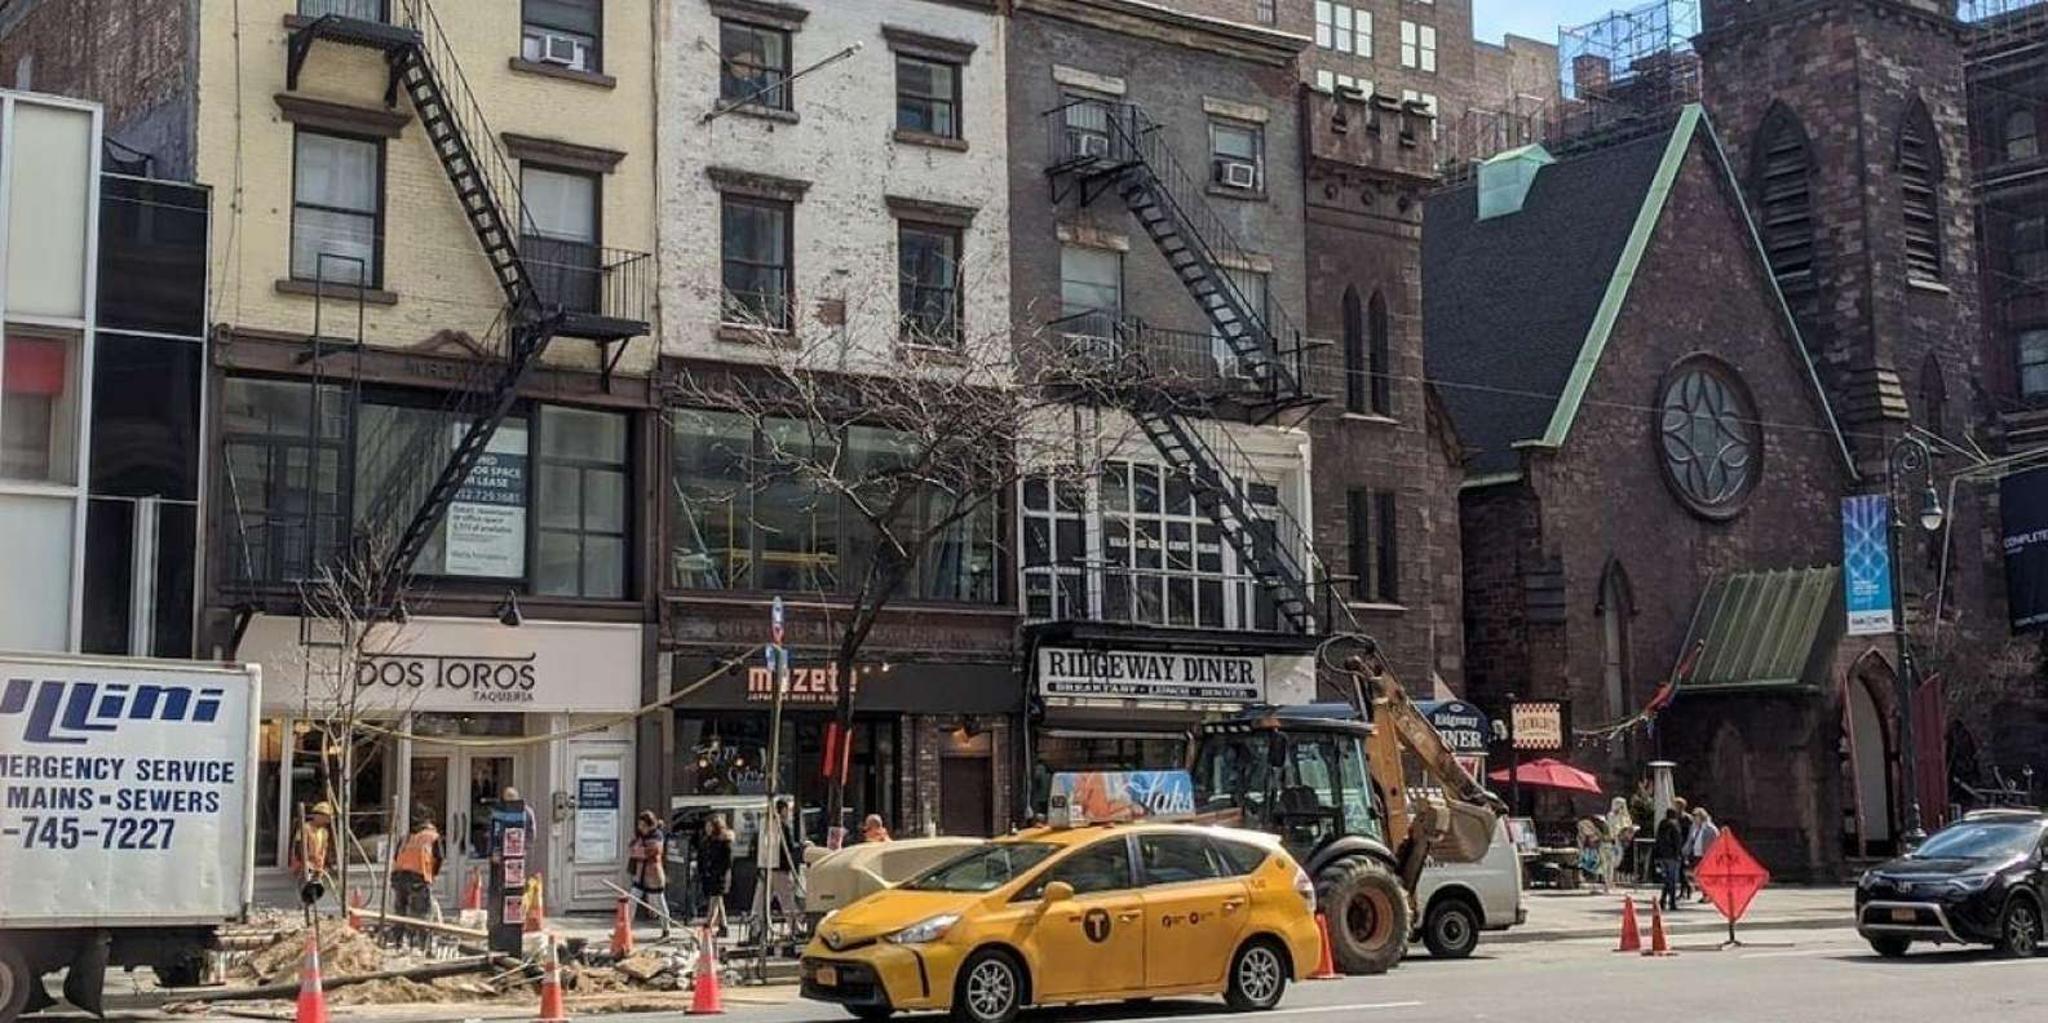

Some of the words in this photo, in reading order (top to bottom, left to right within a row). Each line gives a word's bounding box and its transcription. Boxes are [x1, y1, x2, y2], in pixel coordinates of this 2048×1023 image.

[357, 660, 424, 687] DOS
[435, 657, 536, 691] TOROS
[1048, 650, 1177, 682] RIDGEWAY
[1184, 656, 1255, 684] DINER
[473, 690, 535, 702] TAQUERIA
[1434, 713, 1479, 728] Ridgeway
[1441, 729, 1483, 748] INER
[136, 758, 235, 784] SERVICE
[7, 786, 94, 812] MAINS
[117, 789, 221, 814] SEWERS
